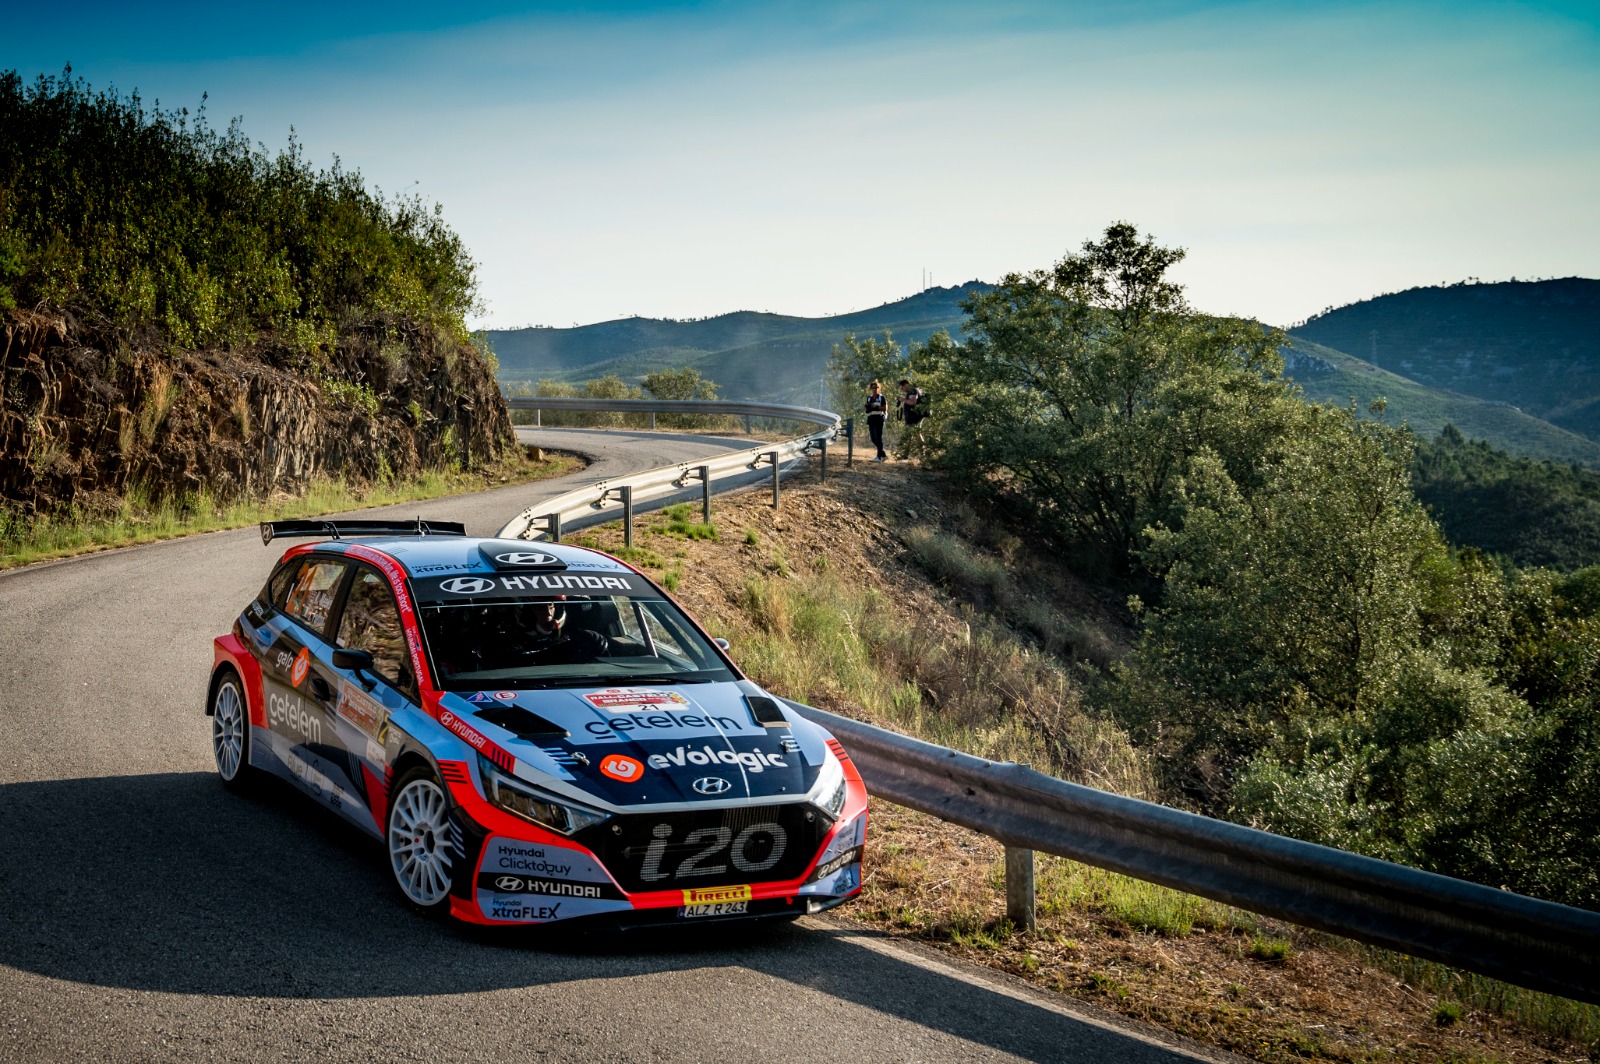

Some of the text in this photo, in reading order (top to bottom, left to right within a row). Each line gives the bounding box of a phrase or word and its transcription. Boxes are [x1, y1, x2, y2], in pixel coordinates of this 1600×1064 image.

[414, 562, 483, 573] xtraFLEX
[499, 576, 632, 590] HYUNDAI
[275, 650, 294, 672] galp
[412, 653, 425, 686] PORTUGAL
[269, 693, 321, 745] cetelem
[585, 711, 743, 740] cetelem
[452, 720, 487, 748] HYUNDAI
[647, 745, 789, 773] evologic
[498, 846, 545, 858] Hyundai
[639, 823, 788, 882] i20
[528, 880, 601, 898] HYUNDAI
[690, 886, 745, 902] PIRELLI
[492, 902, 562, 919] xtraFLEX
[493, 898, 522, 907] Hyundai
[686, 902, 746, 917] ALZ R 243
